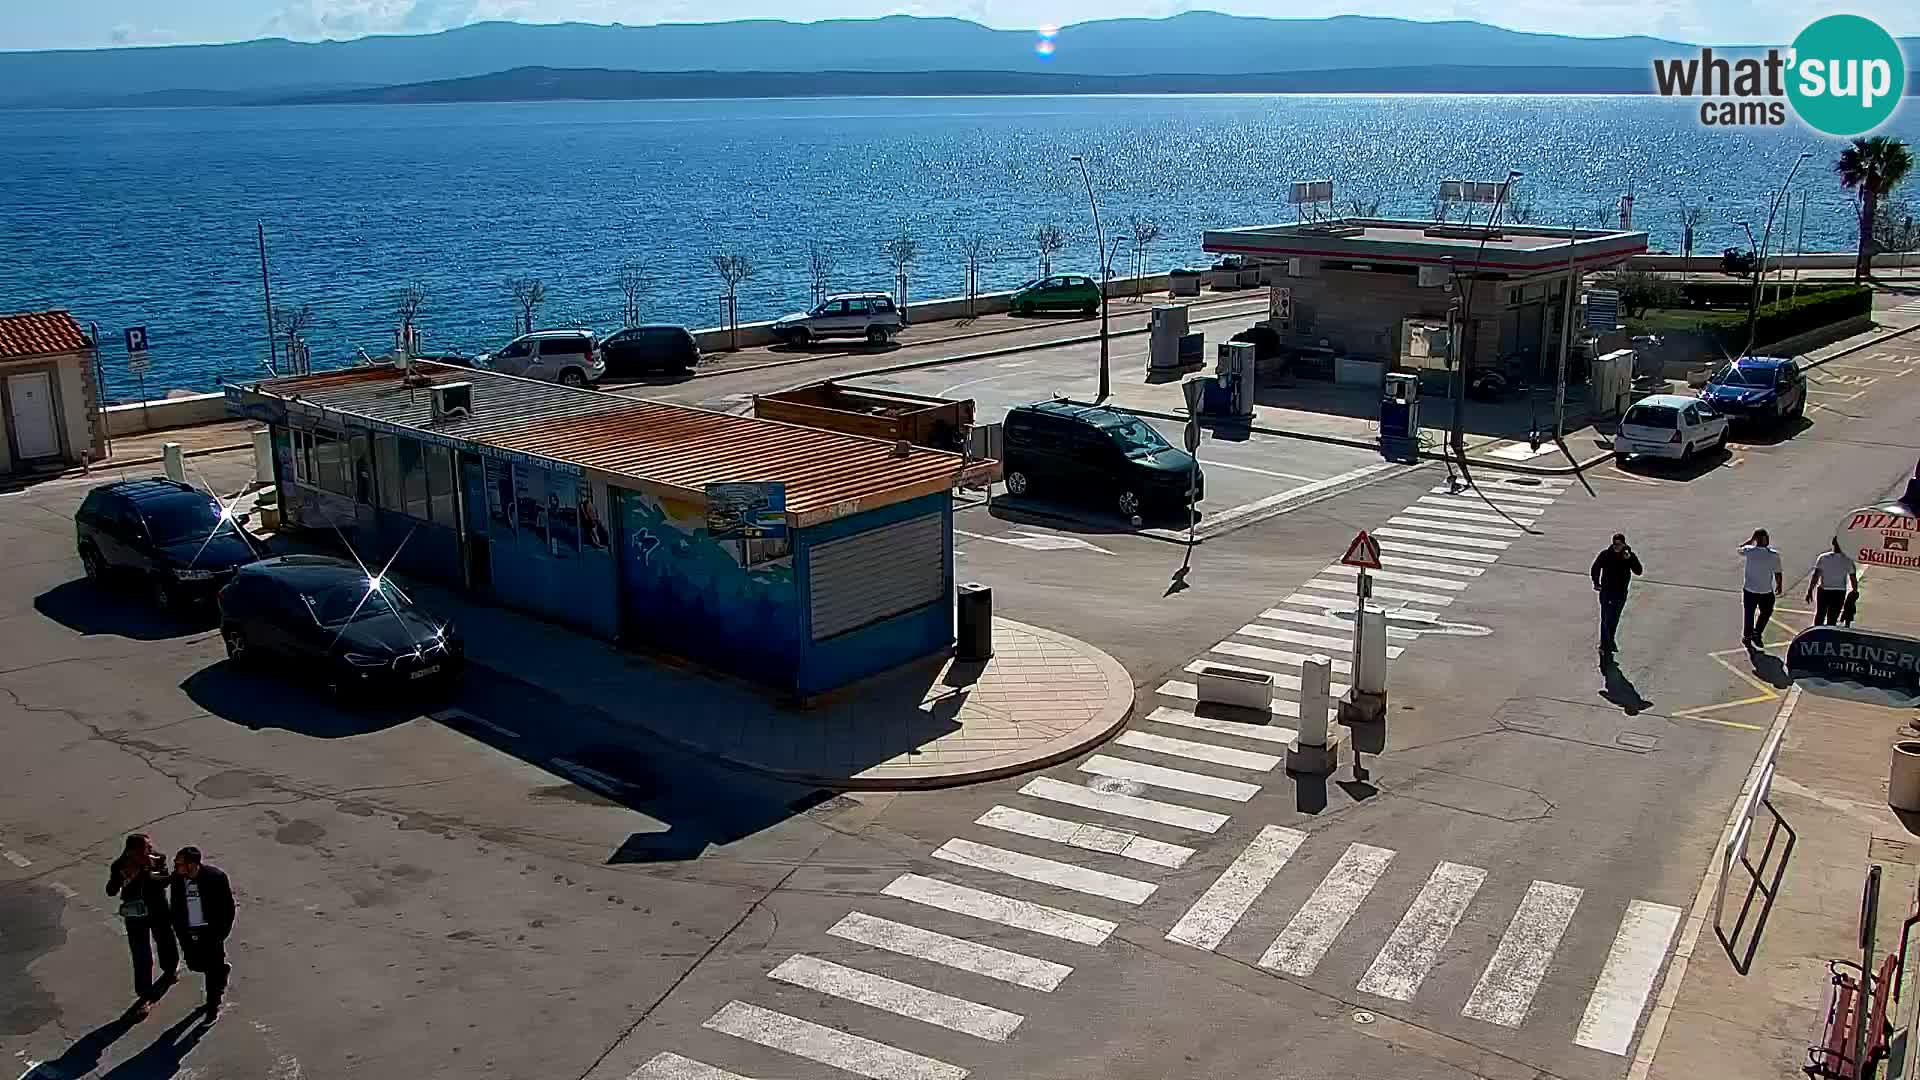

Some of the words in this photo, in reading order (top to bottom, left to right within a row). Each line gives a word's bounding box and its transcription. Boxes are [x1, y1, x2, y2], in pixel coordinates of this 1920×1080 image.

[130, 330, 141, 348] P
[554, 463, 581, 476] OFFICE
[1869, 664, 1896, 679] bar
